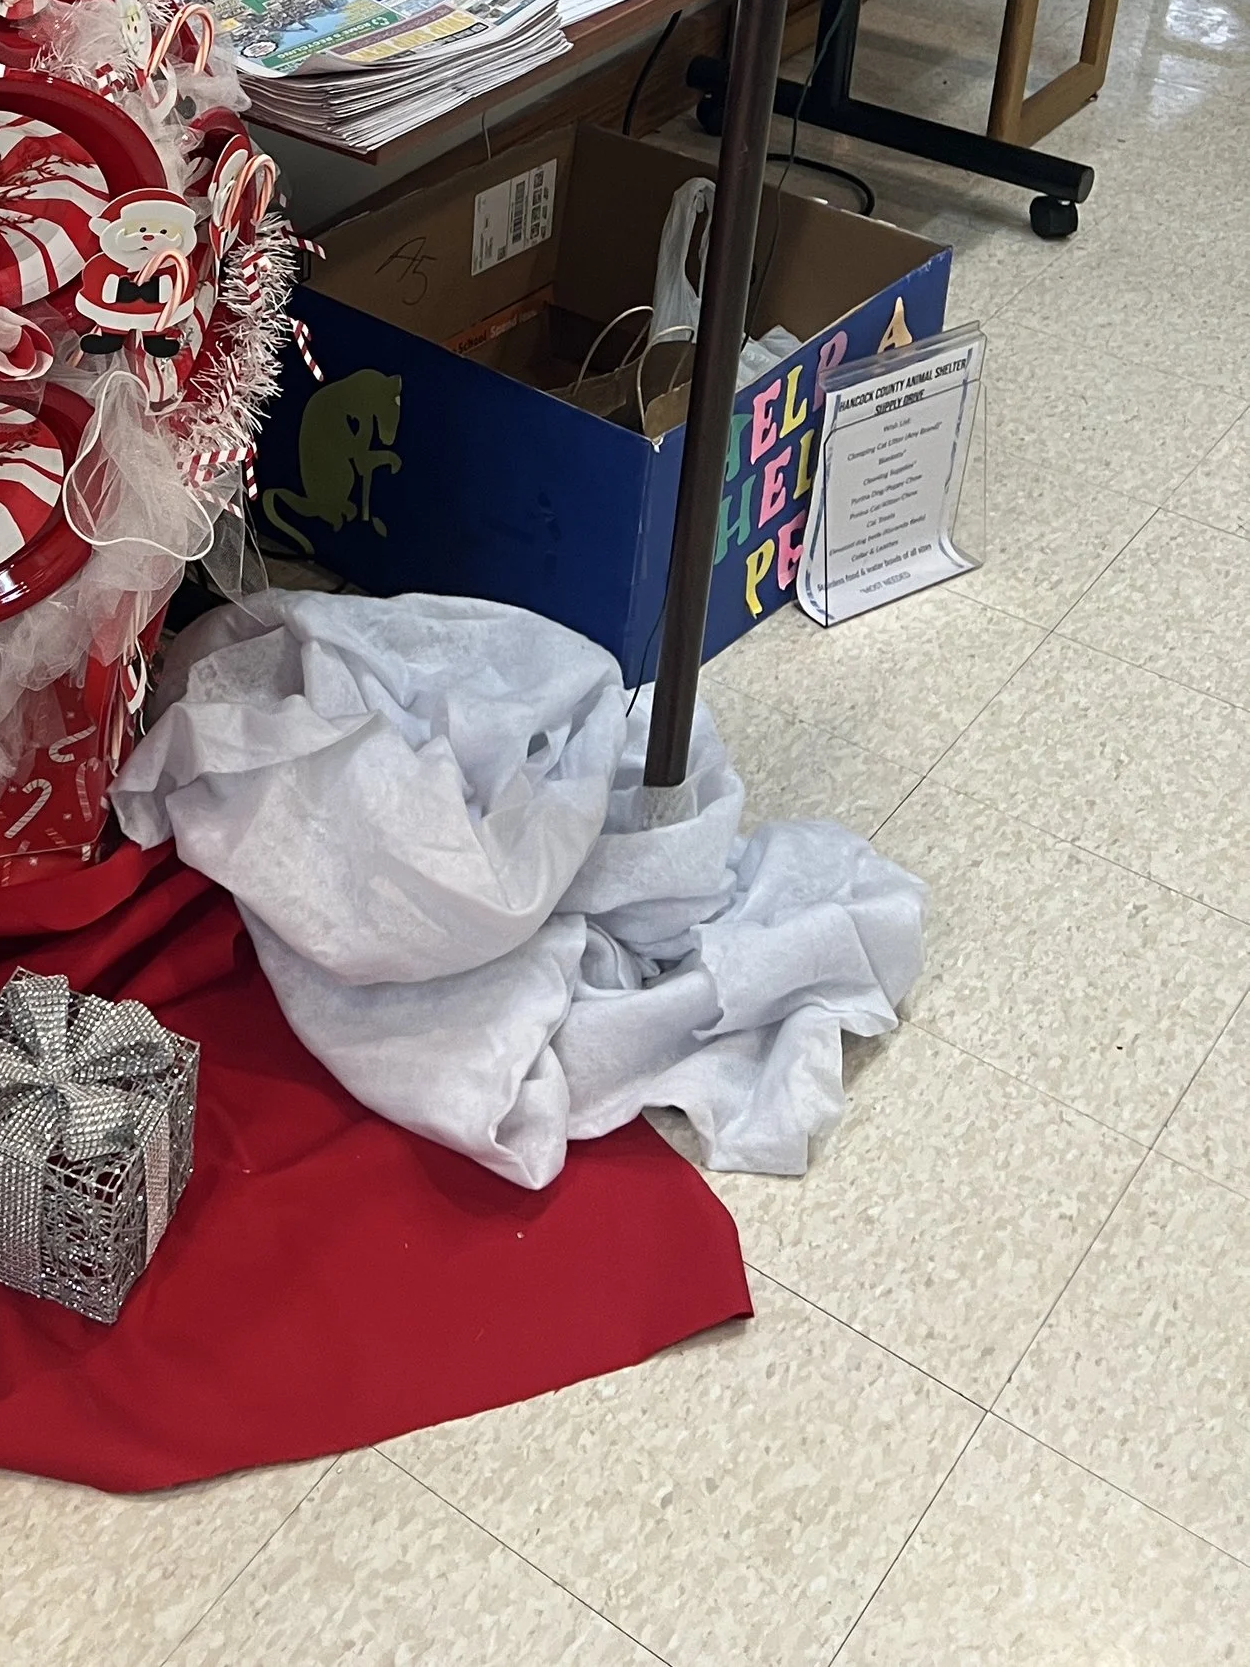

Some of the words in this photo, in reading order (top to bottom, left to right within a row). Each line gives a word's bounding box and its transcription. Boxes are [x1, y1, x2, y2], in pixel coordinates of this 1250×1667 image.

[839, 392, 875, 412] HANCOCK
[875, 379, 906, 400] COUNTY
[905, 370, 933, 389] ANIMAL
[934, 358, 967, 378] SHELTER
[874, 398, 904, 415] SUPPLY
[903, 389, 925, 407] DRIVE
[713, 430, 814, 565] HEL
[745, 510, 805, 618] PE
